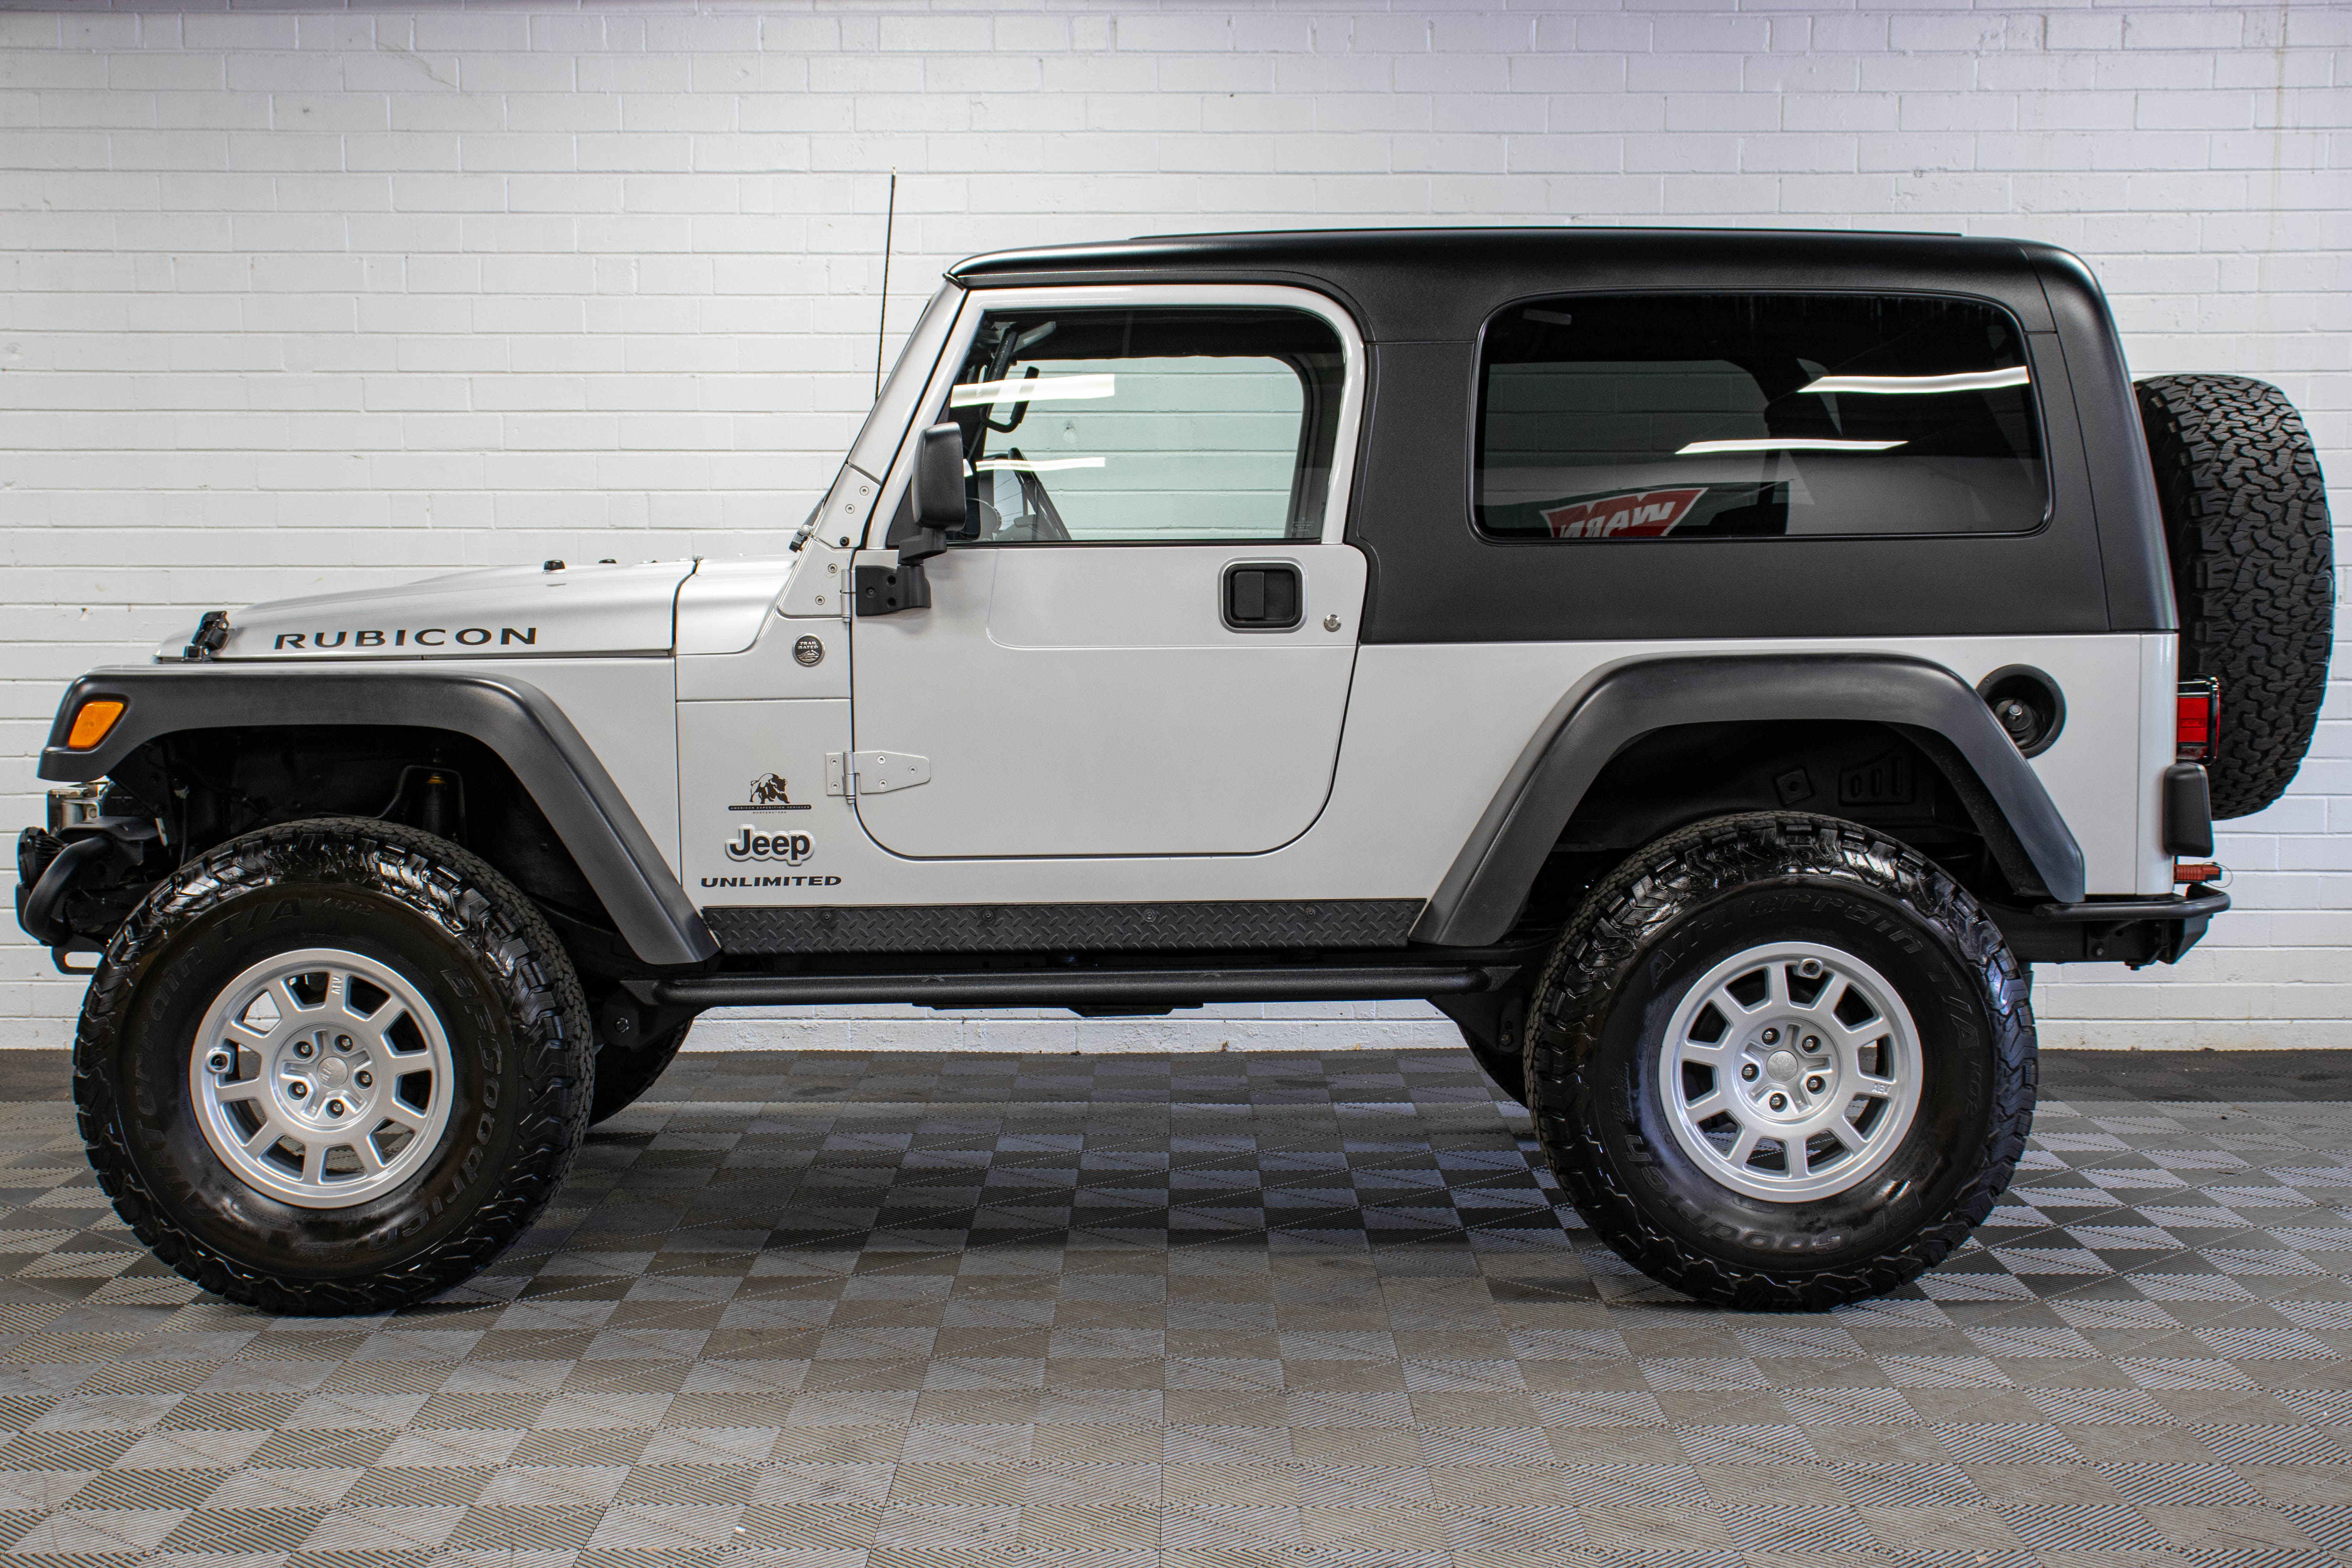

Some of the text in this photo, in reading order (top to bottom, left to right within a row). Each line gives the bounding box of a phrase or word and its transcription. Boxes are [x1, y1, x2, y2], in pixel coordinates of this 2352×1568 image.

[274, 627, 537, 650] RUBICON
[730, 829, 810, 860] Jeep
[701, 876, 842, 887] UNLIMITED
[1871, 1083, 1890, 1095] AEV
[368, 969, 502, 1252] BFGoodrich
[1624, 1135, 1923, 1255] BFGoodrich
